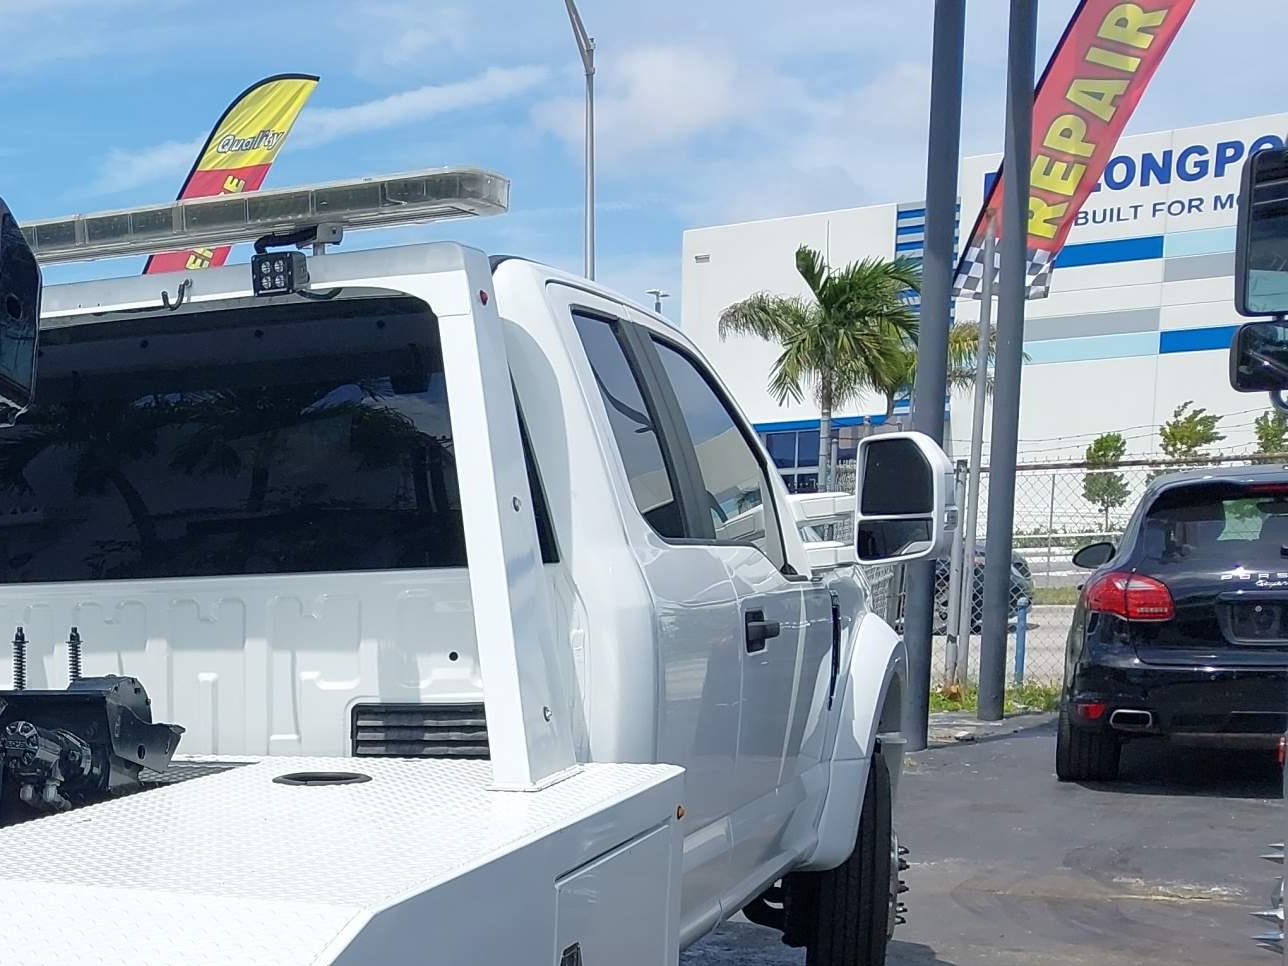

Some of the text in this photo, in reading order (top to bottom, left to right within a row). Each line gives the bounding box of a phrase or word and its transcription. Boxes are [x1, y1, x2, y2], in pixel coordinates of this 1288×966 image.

[217, 130, 284, 154] Quality
[1027, 2, 1168, 240] REPAIR
[1090, 134, 1286, 193] ONGP
[1074, 192, 1242, 227] BUILT FOR M
